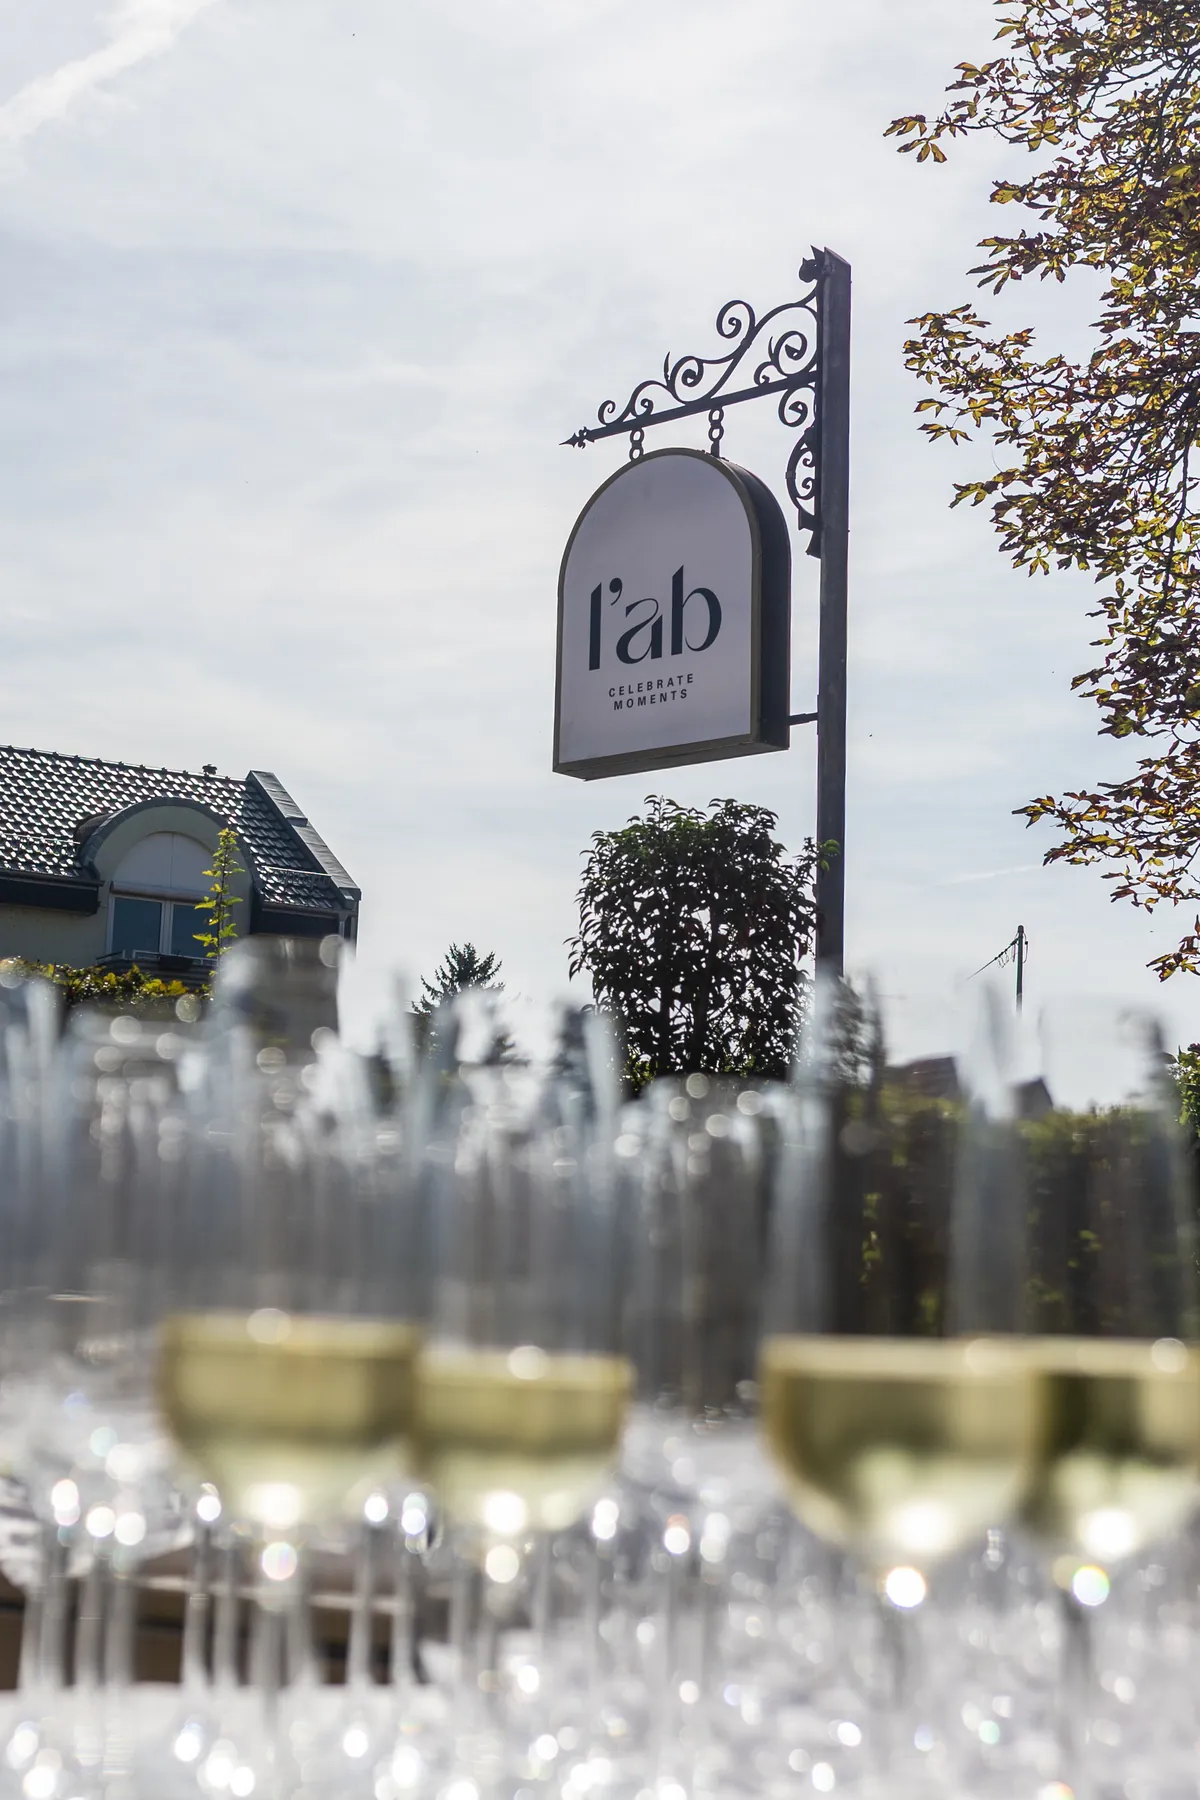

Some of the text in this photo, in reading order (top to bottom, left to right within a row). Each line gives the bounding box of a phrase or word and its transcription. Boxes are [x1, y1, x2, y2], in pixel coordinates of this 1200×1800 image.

[589, 565, 722, 671] l'ab
[608, 673, 694, 698] CELEBRATE
[613, 688, 688, 711] MOMENTS
